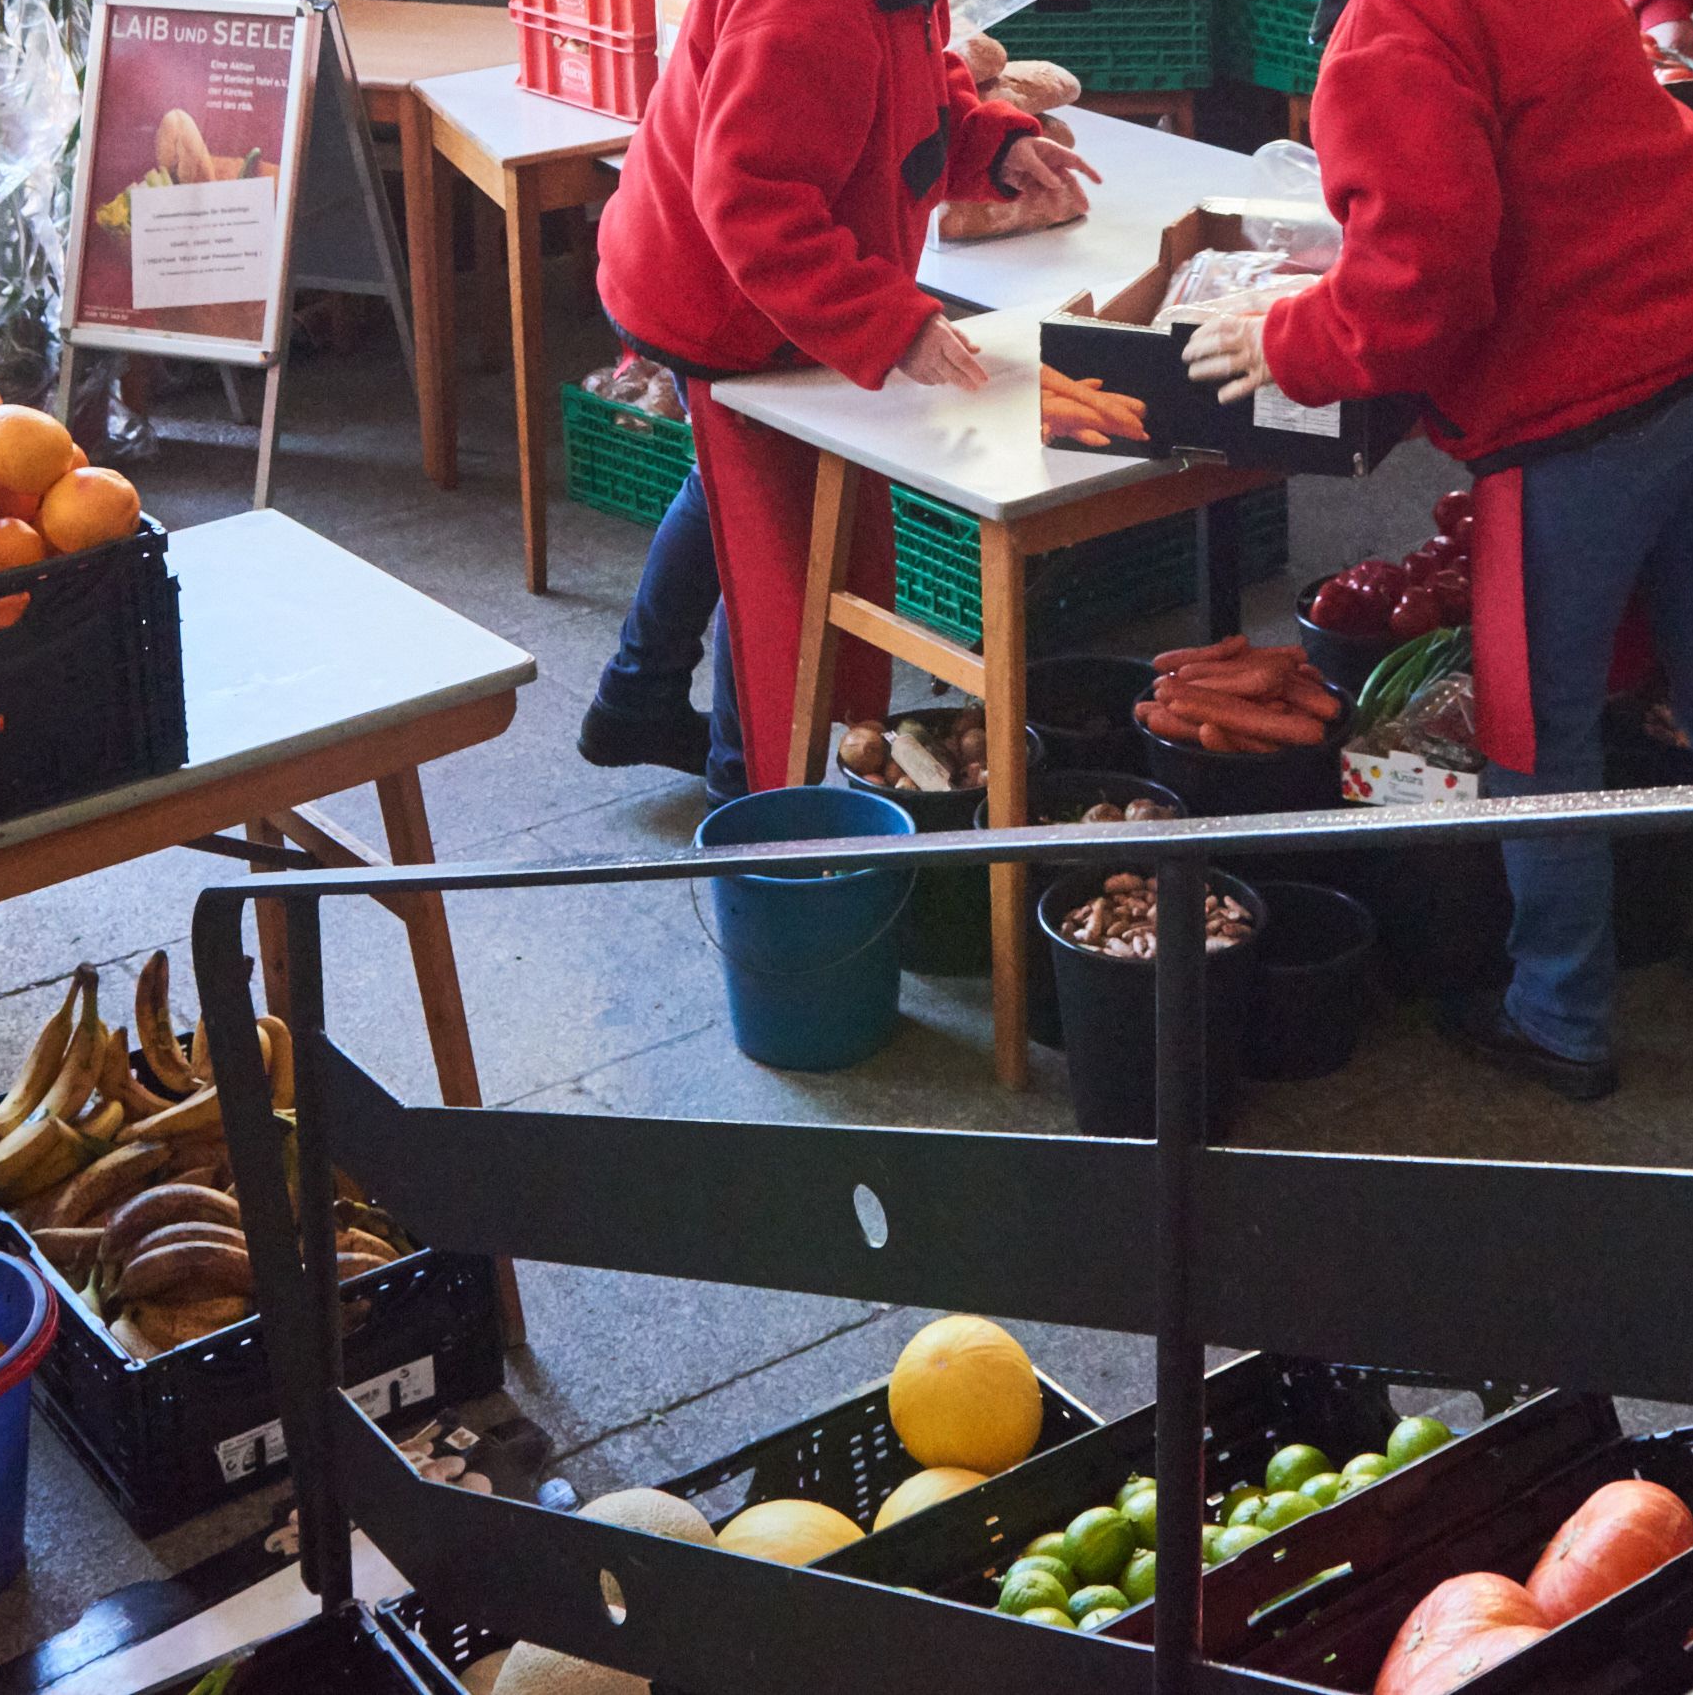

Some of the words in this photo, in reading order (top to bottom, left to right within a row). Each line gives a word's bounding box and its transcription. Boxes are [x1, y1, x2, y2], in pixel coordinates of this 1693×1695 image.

[112, 14, 169, 42] LAIB
[174, 27, 207, 43] UND
[212, 20, 294, 50] SEELE
